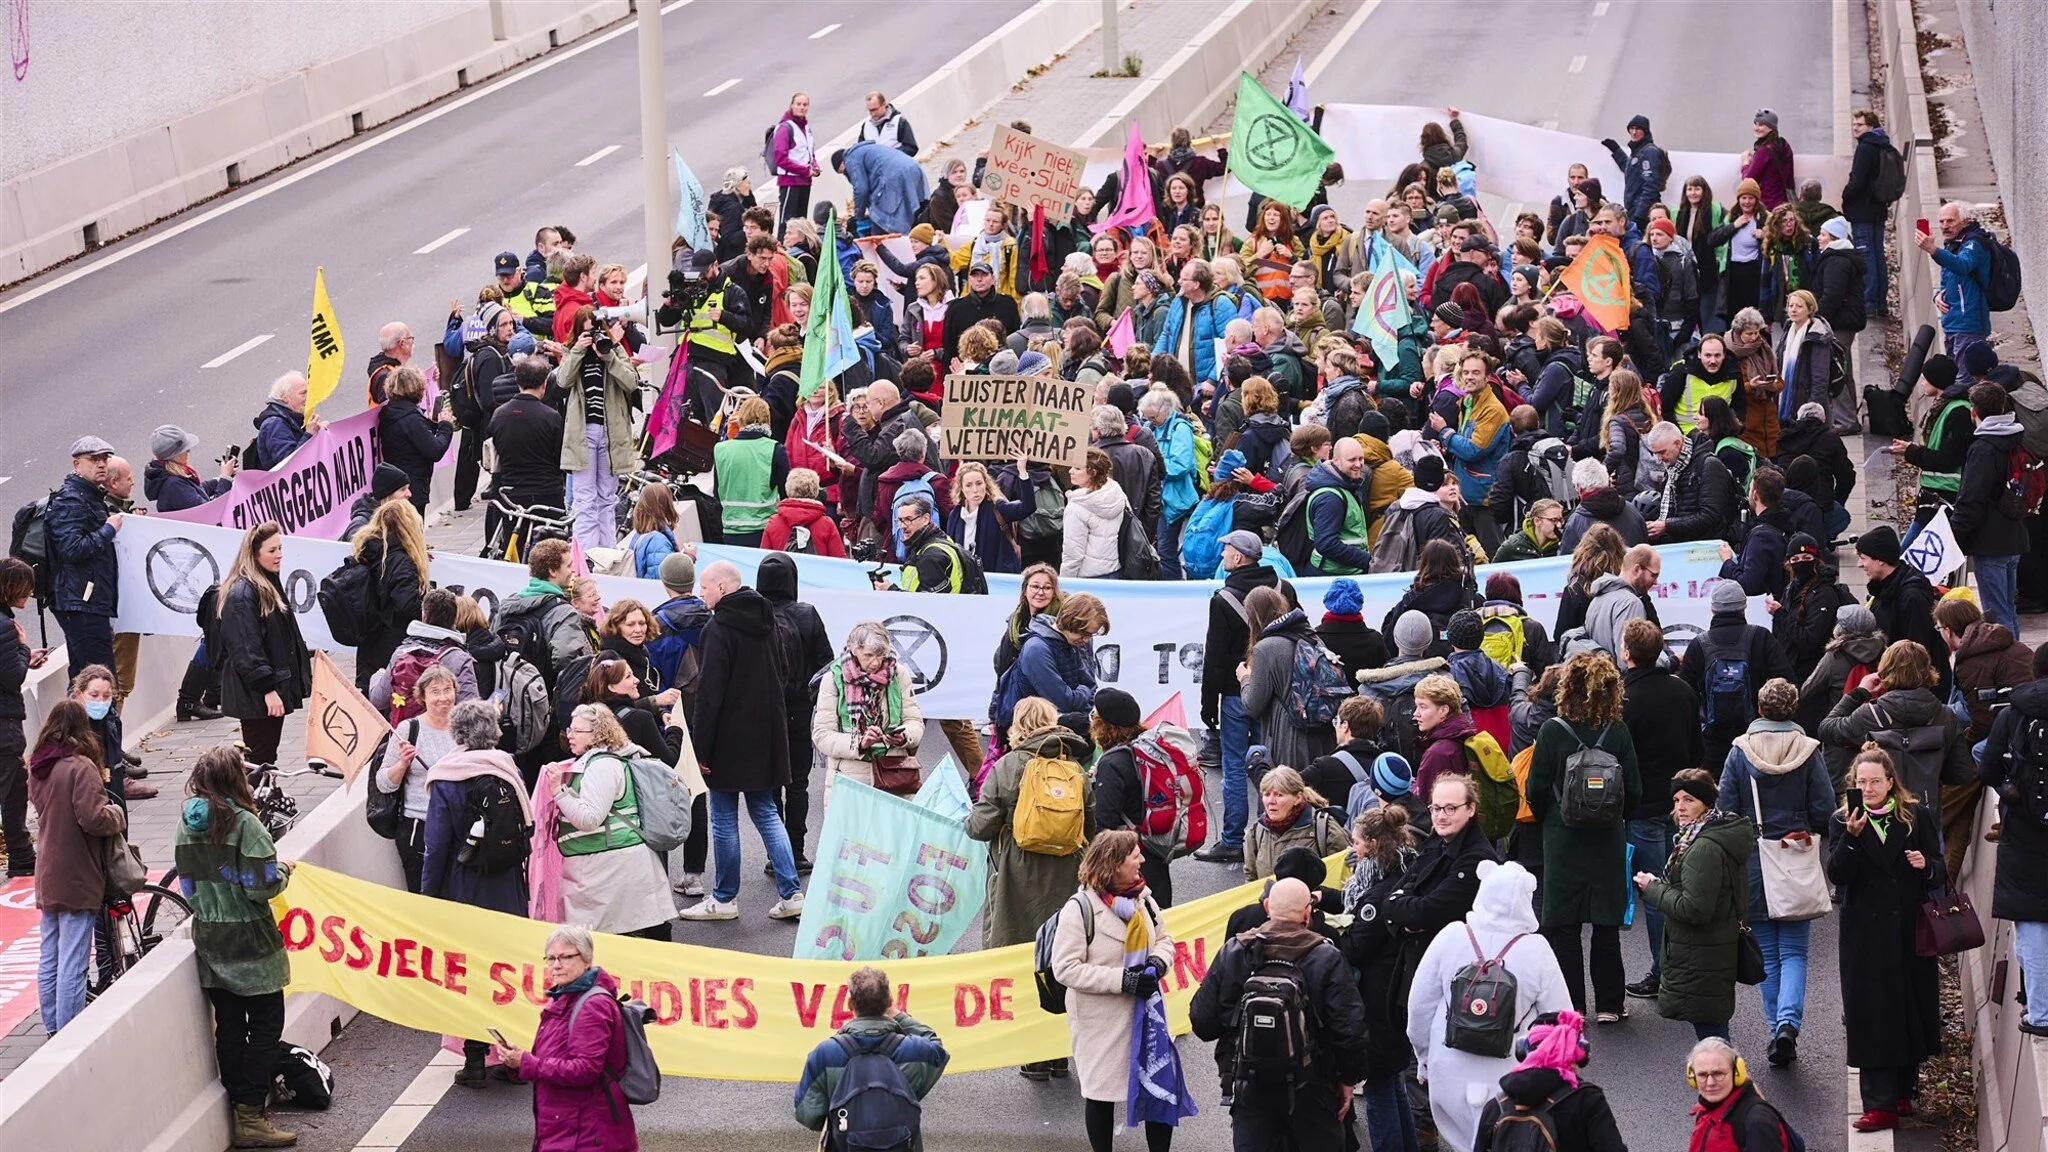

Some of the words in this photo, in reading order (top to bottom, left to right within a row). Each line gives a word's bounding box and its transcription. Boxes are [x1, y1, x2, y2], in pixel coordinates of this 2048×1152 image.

[1043, 151, 1073, 176] niet
[1000, 178, 1020, 200] je
[311, 312, 339, 360] TIME
[948, 379, 1027, 405] LUISTER
[1033, 381, 1086, 413] NAAR
[962, 406, 1069, 433] KLIMAAT-
[945, 428, 1077, 461] WETENSCHAP
[333, 435, 367, 506] NAAR
[278, 907, 467, 995] OSSIELE
[954, 978, 1014, 1027] DE
